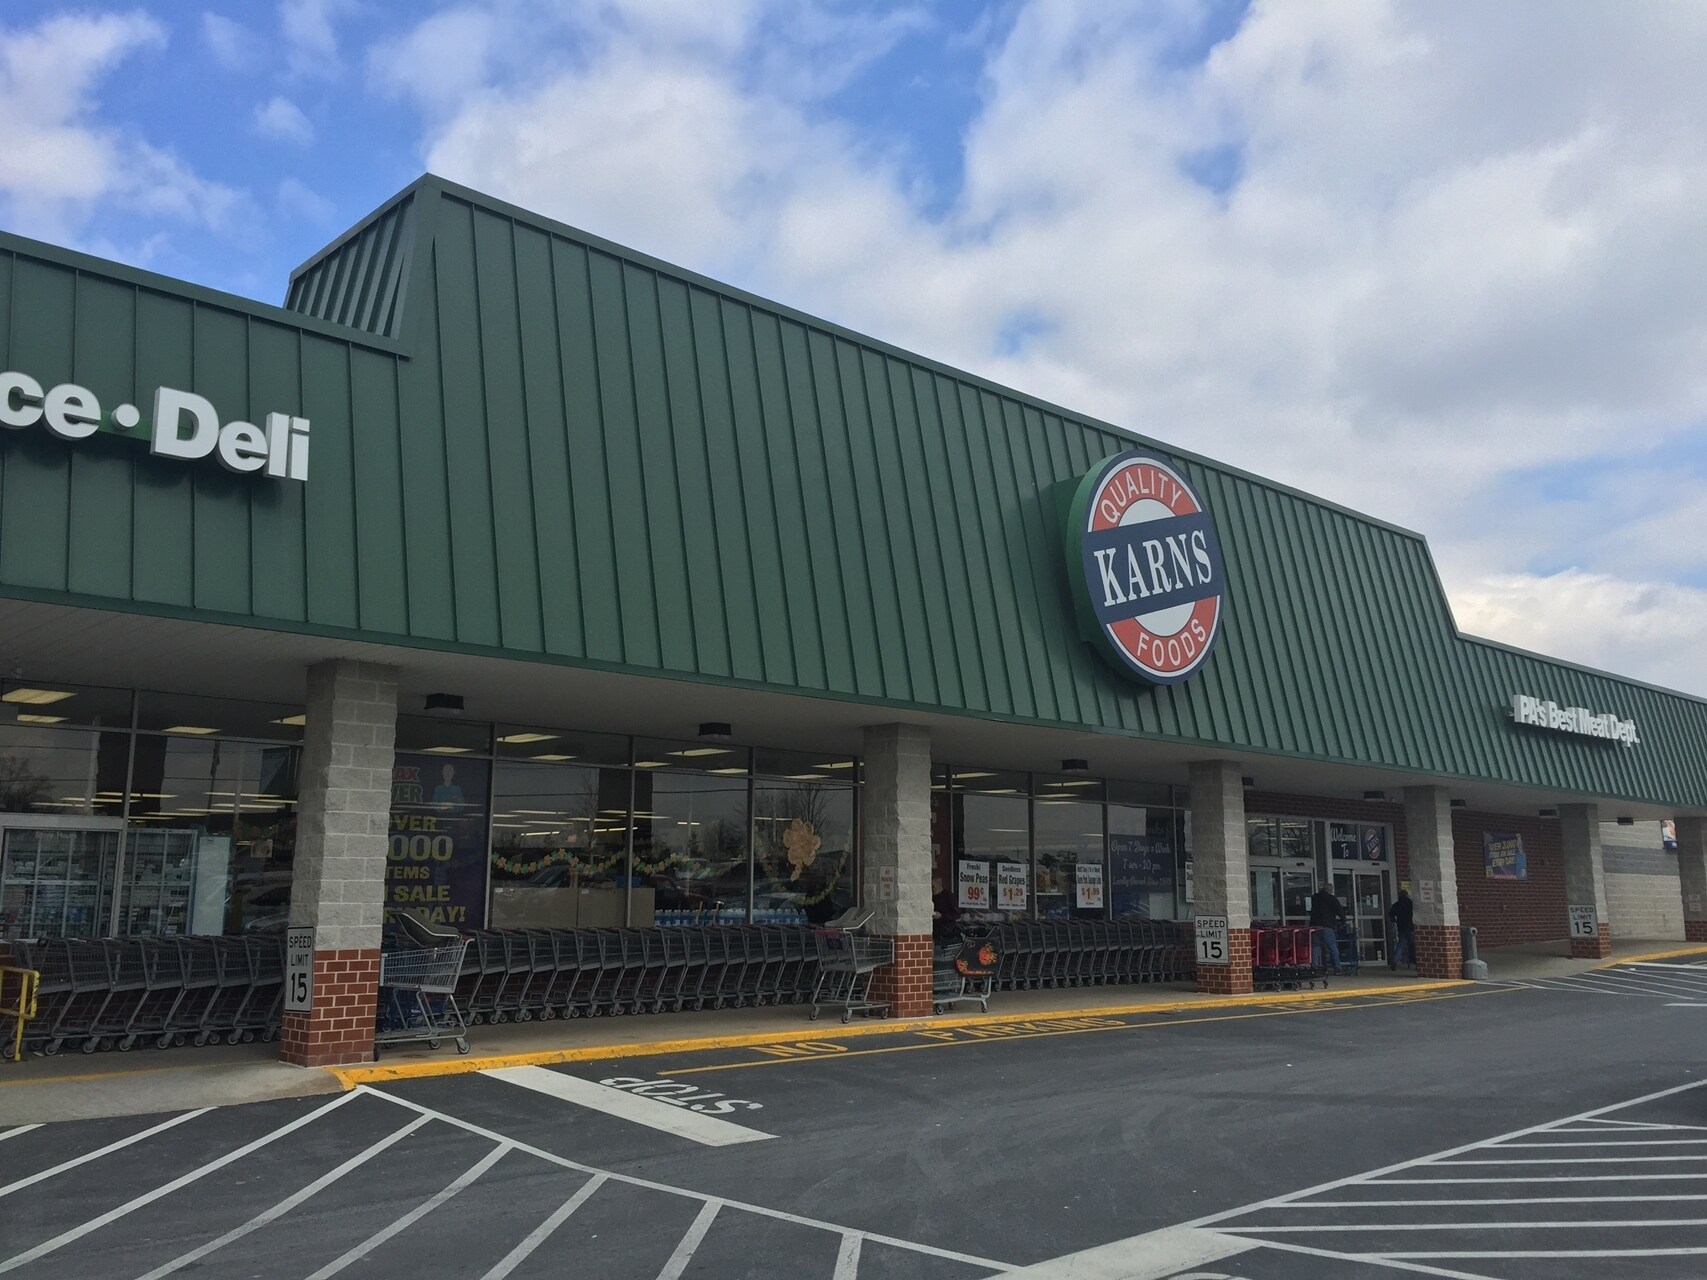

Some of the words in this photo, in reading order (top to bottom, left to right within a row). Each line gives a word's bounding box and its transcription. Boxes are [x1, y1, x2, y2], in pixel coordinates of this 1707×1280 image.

[151, 386, 310, 481] Deli
[1101, 468, 1182, 524] QUALITY
[1093, 529, 1213, 607] KARNS
[1137, 618, 1206, 667] FOODS
[1514, 695, 1548, 727] PA's
[1547, 701, 1579, 733] Best
[1578, 707, 1610, 739] Meat
[1609, 714, 1640, 748] Dept.
[960, 872, 975, 883] Snow
[976, 873, 988, 884] Peas
[999, 875, 1008, 884] Red
[1009, 875, 1025, 886] Grapes
[394, 885, 450, 900] SALE
[1197, 920, 1226, 928] SPEED
[1574, 921, 1593, 934] 15
[289, 936, 312, 948] SPEED
[1200, 930, 1222, 938] LIMIT
[1202, 941, 1222, 959] 15
[291, 954, 309, 966] LIMIT
[291, 973, 307, 1003] 15
[912, 1018, 1127, 1041] PARKING
[599, 1077, 764, 1114] STOP
